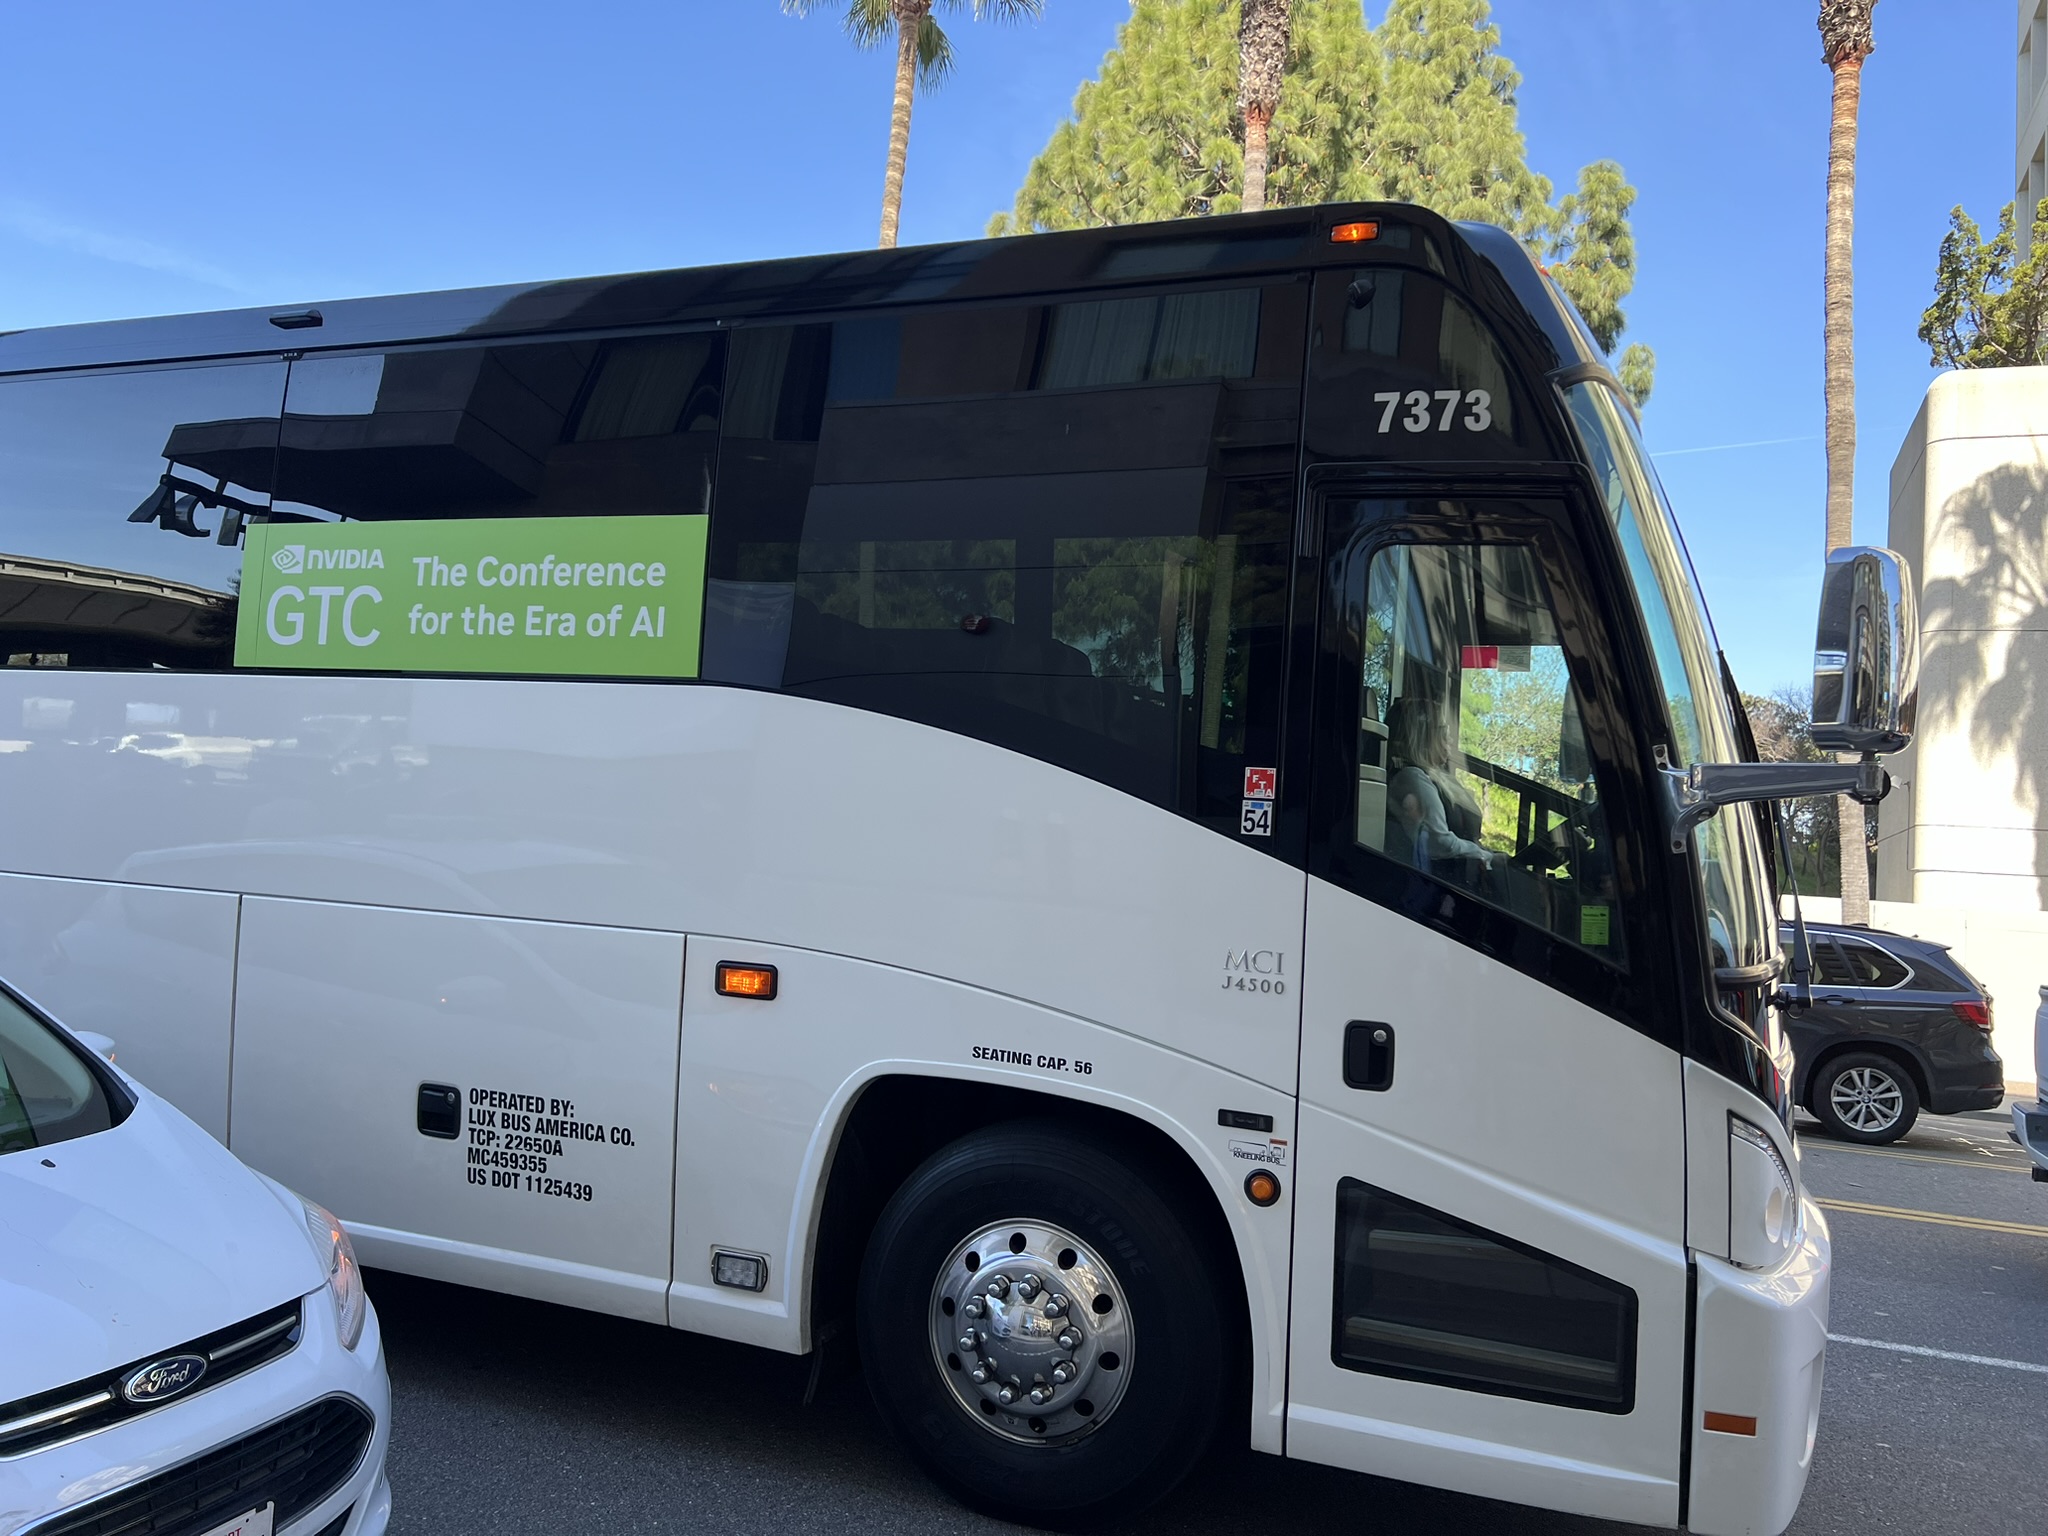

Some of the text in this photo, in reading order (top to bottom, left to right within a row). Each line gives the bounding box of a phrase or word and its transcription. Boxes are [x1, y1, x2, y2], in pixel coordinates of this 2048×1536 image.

[1374, 389, 1492, 433] 7373
[412, 553, 666, 587] The Conference
[265, 584, 383, 647] GTC
[408, 603, 666, 638] for the Era of AI
[1242, 809, 1270, 834] 54
[1223, 947, 1285, 976] MCI
[1221, 976, 1285, 995] J4500
[972, 1046, 1093, 1074] SEATING CAP. 56
[469, 1088, 575, 1118] OPERATED BY:
[468, 1108, 635, 1147] LUX BUS AMERICA CO.
[468, 1127, 563, 1156] TCP: 22650A
[467, 1147, 547, 1174] MC459355
[1233, 1150, 1280, 1164] KNEELING BUS
[467, 1167, 593, 1202] US DOT 1125439
[147, 1362, 190, 1393] Ford
